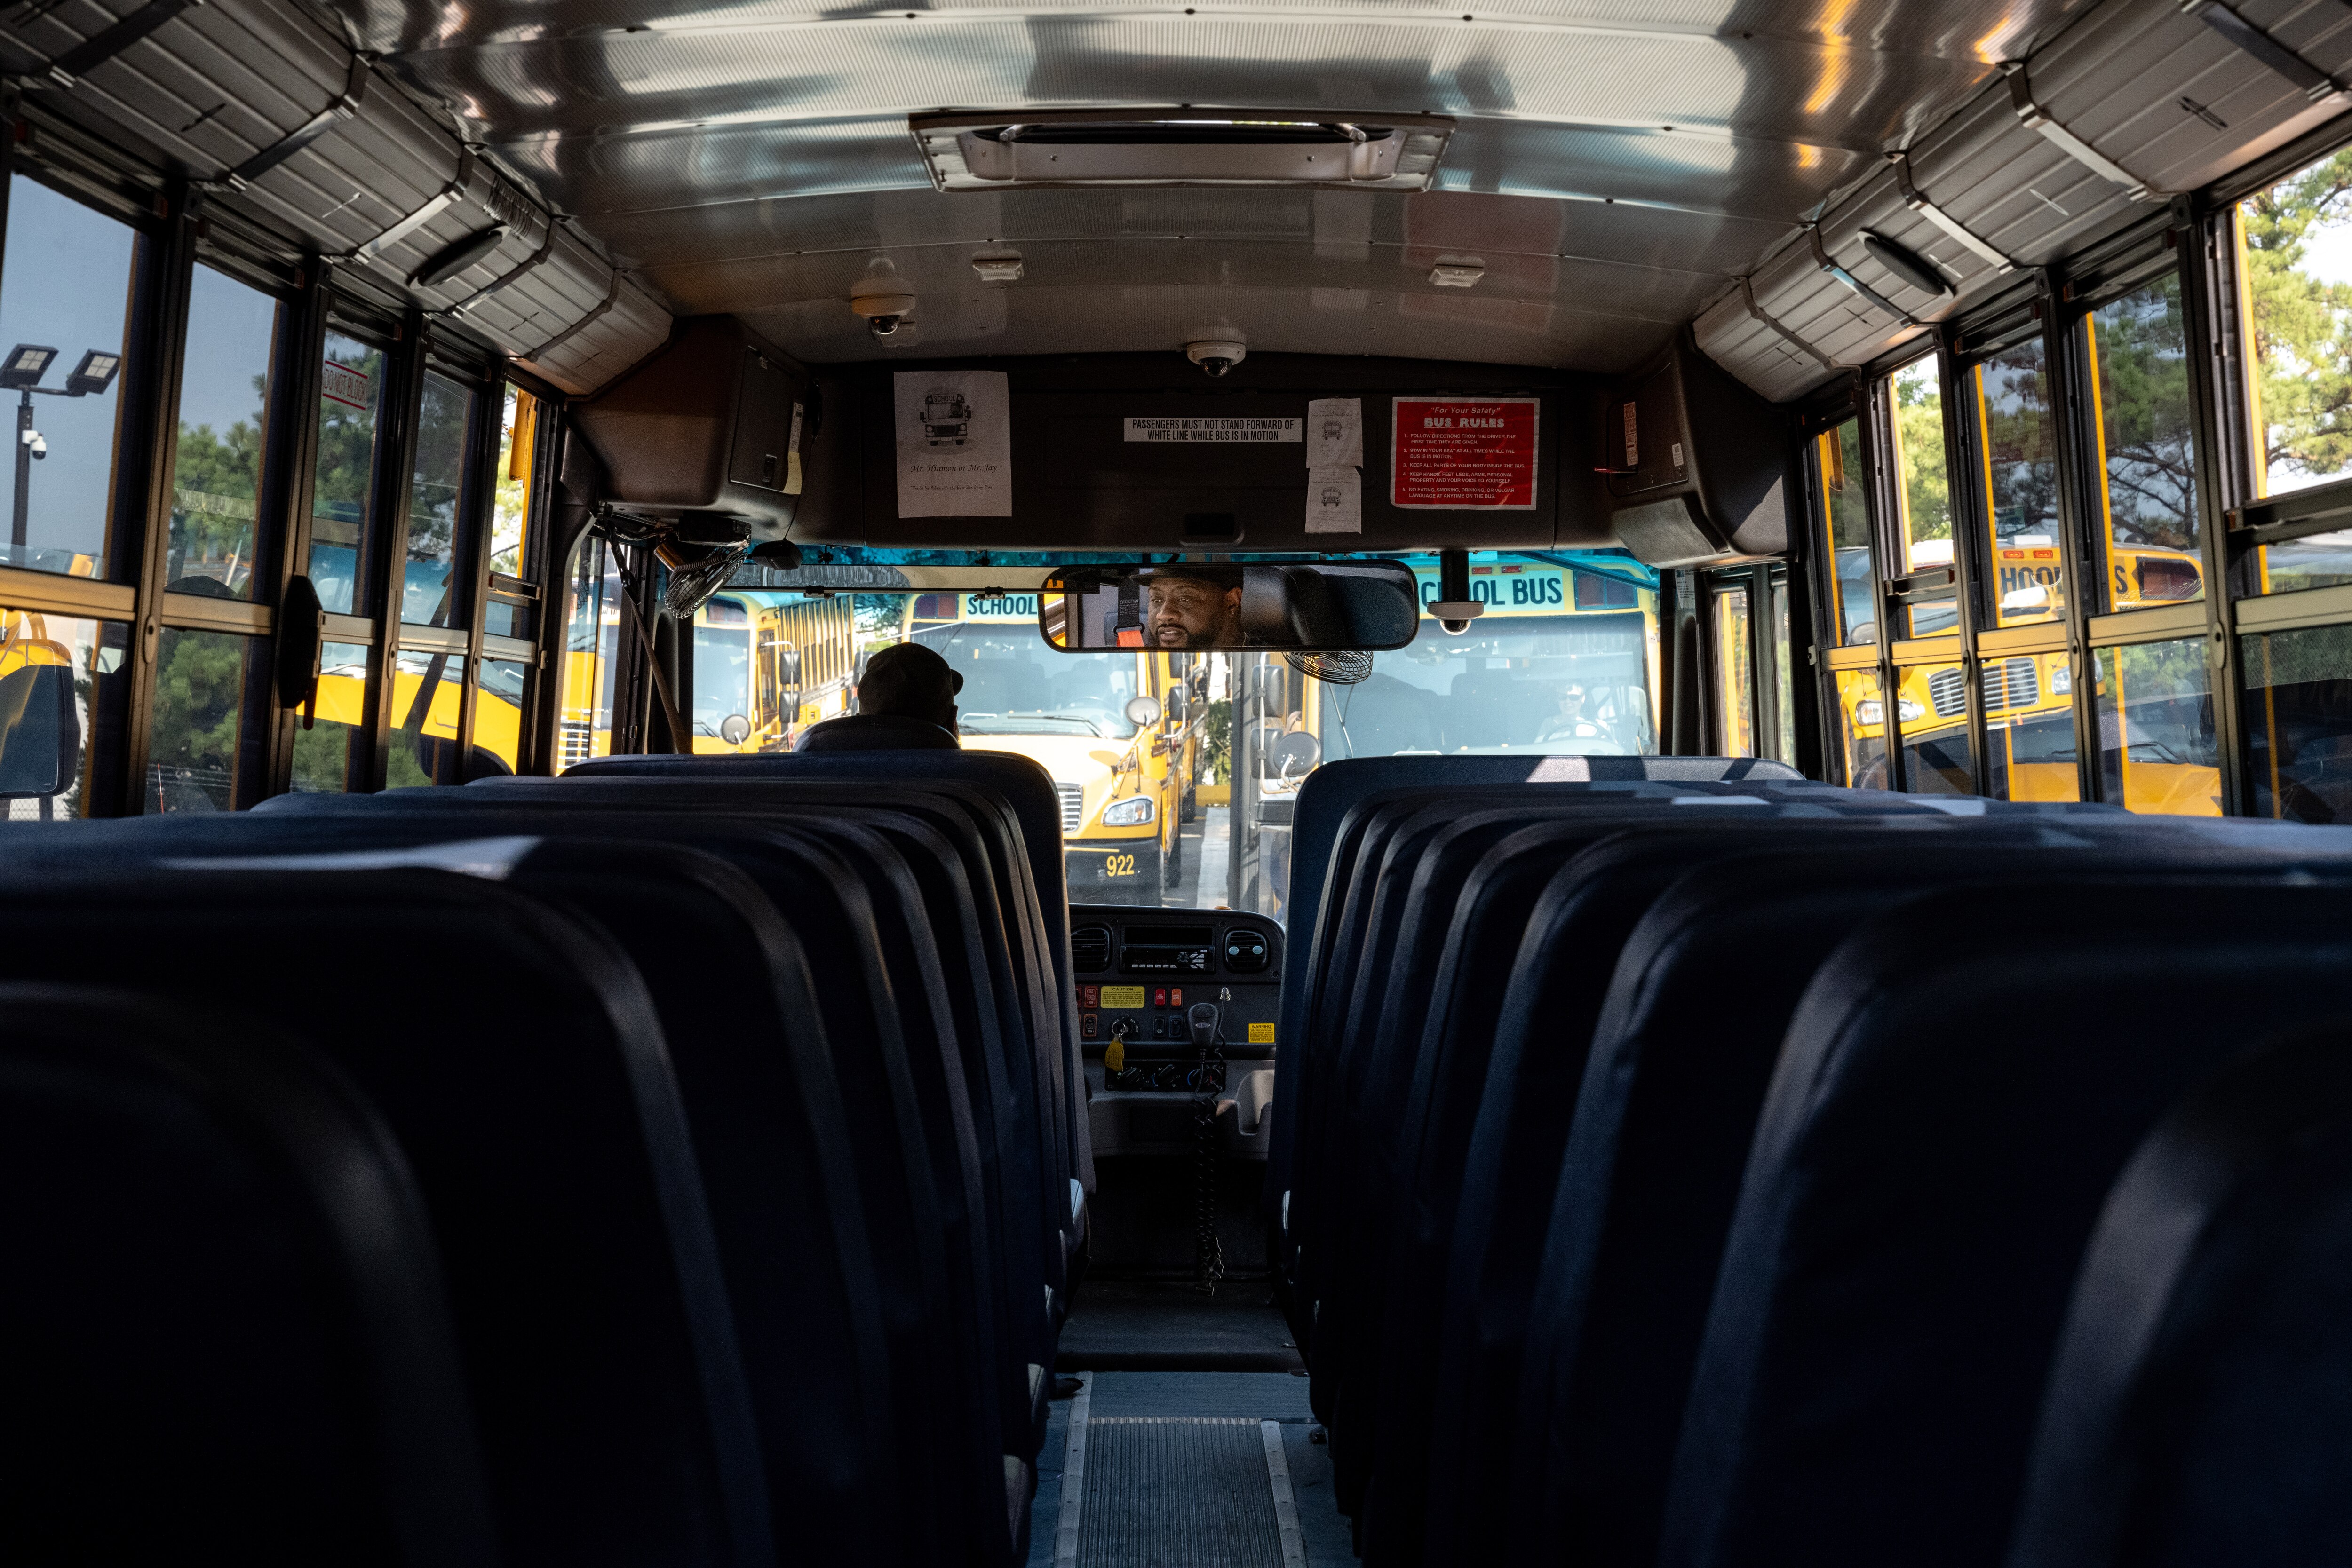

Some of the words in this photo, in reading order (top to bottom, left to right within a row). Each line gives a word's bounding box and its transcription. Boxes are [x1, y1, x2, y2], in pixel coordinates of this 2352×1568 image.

[324, 369, 334, 390] DO
[334, 372, 346, 394] NOT
[1133, 420, 1179, 429] PASSENGERS
[1182, 420, 1202, 429] MUST
[1205, 420, 1219, 429] NOT
[1221, 420, 1244, 429] STAND
[1247, 420, 1282, 429] FORWARD
[1285, 420, 1294, 429] OF
[1424, 417, 1452, 427] BUS
[1460, 418, 1504, 428] RULES
[1148, 430, 1170, 440] WHITE
[1173, 431, 1188, 440] LINE
[1191, 430, 1213, 440] WHILE
[1216, 430, 1229, 440] BUS
[1232, 431, 1238, 440] IS
[1241, 431, 1248, 440] IN
[1250, 431, 1279, 440] MOTION
[984, 464, 997, 473] Jay
[1512, 578, 1562, 604] BUS
[968, 597, 1037, 615] SCHOOL
[1107, 854, 1134, 877] 922
